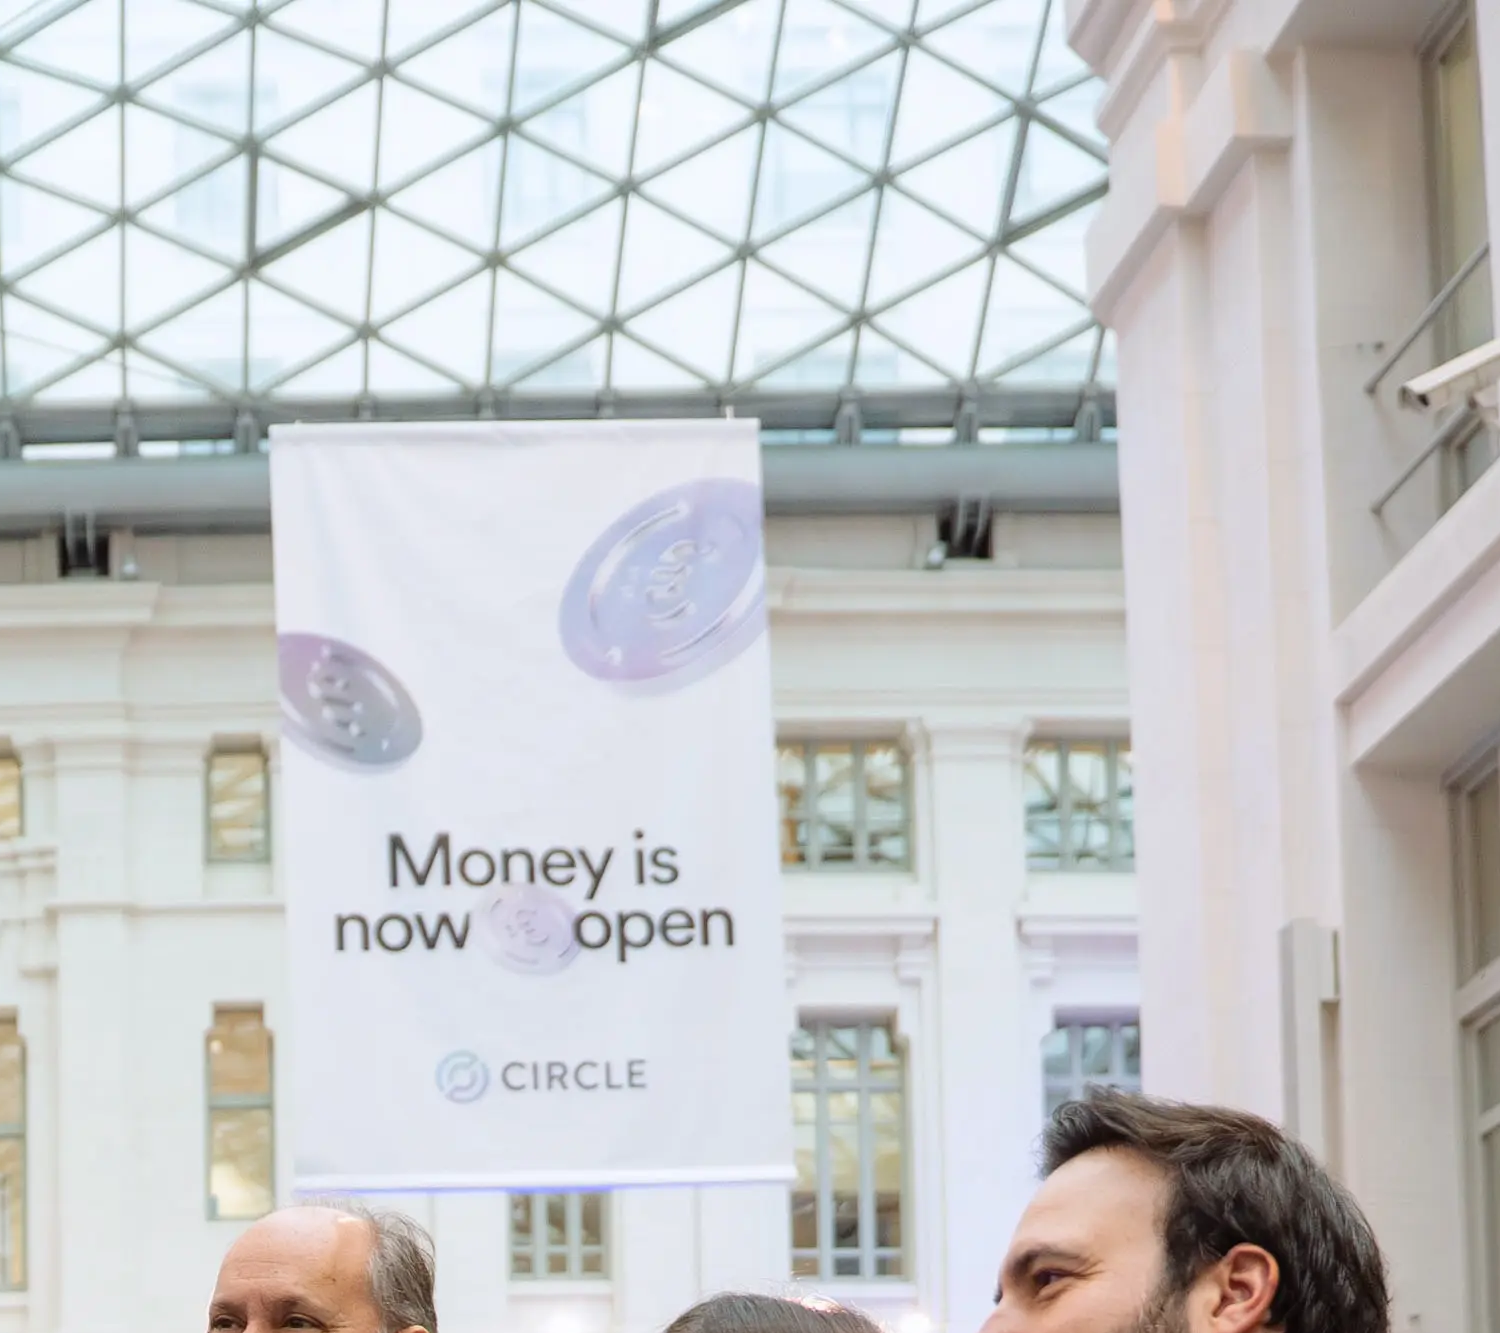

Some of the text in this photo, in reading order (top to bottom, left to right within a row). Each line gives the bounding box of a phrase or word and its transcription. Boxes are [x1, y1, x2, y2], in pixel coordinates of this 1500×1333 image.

[387, 830, 679, 899] Money is
[335, 905, 736, 962] now open
[501, 1059, 648, 1092] CIRCLE
